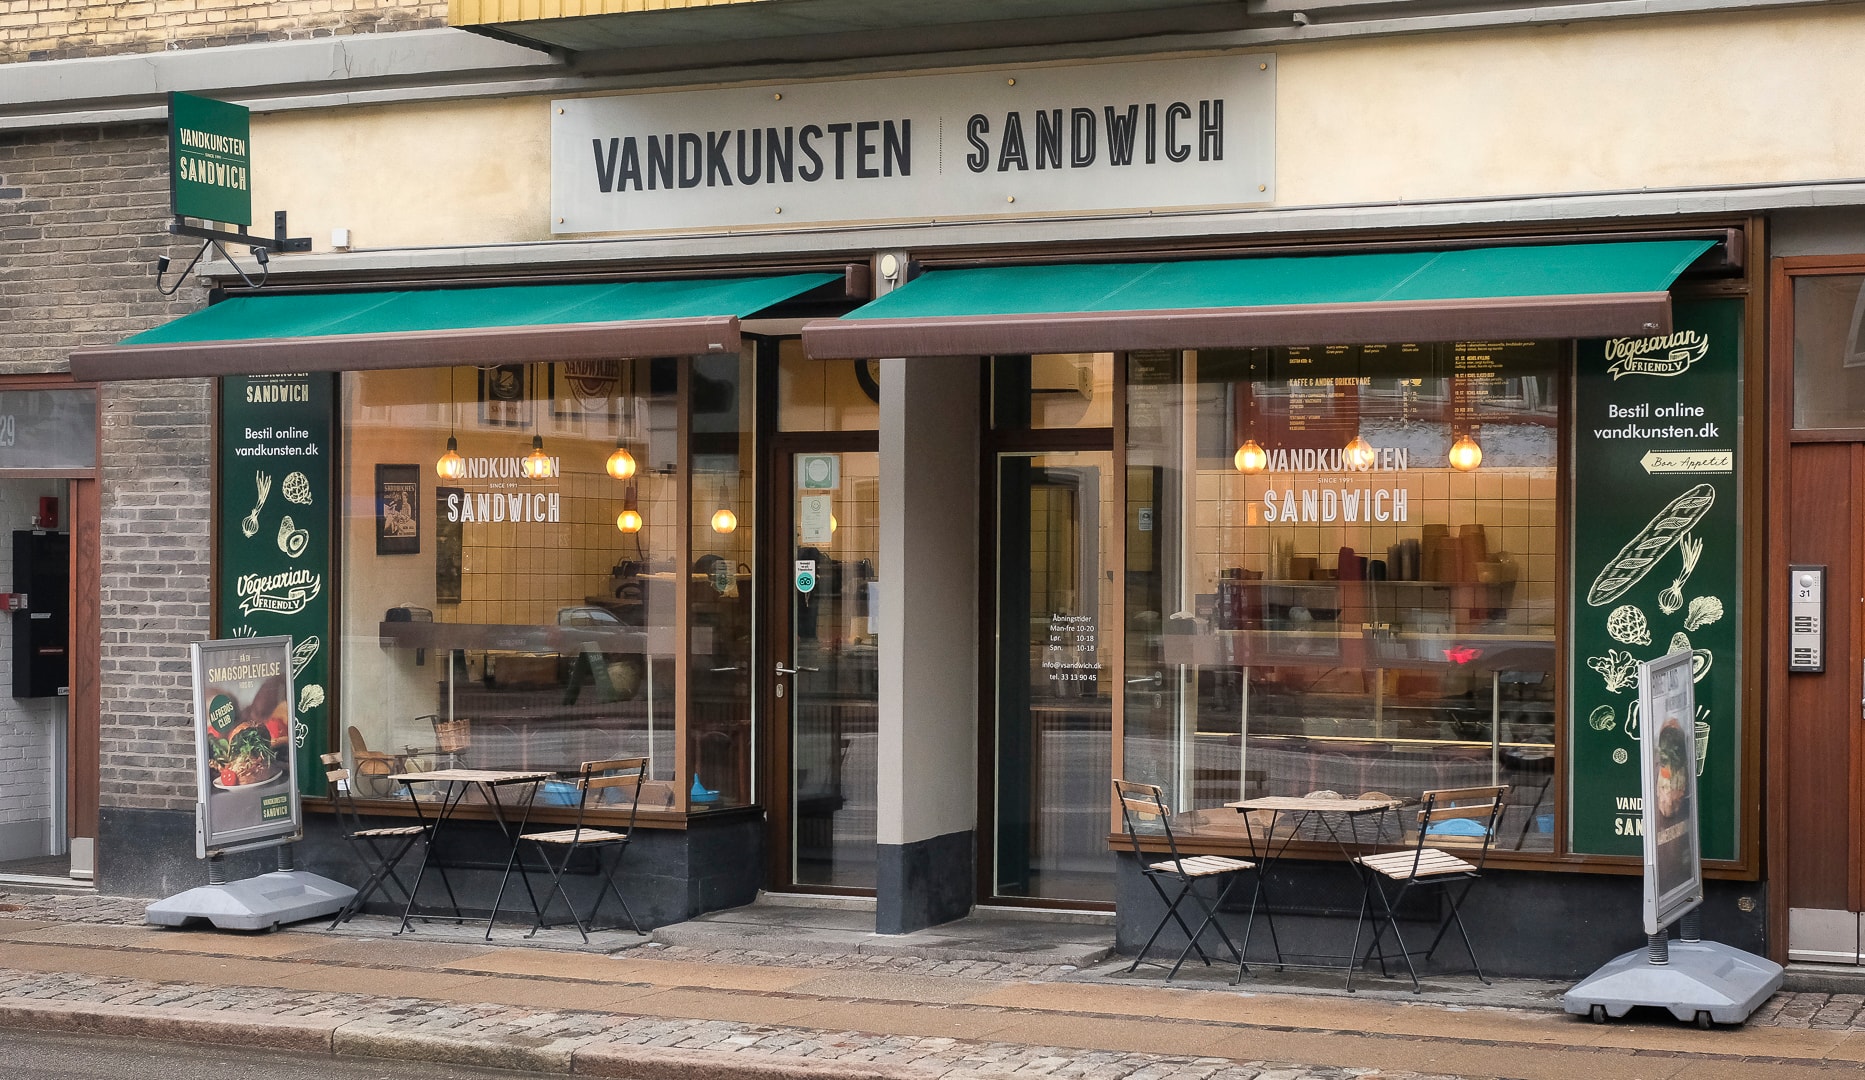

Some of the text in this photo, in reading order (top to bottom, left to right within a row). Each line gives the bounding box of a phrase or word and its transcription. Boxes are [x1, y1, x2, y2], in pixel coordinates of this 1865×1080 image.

[180, 127, 246, 156] VANDKUNSTEN
[592, 99, 1225, 193] VANDKUNSTEN SANDWICH
[180, 156, 247, 191] SANDWICH
[1604, 329, 1702, 371] Vegetarian
[1631, 361, 1684, 372] FRIENDLY
[1289, 377, 1308, 387] KAFFE
[246, 384, 309, 403] SANDWICH
[1608, 402, 1705, 418] Bestil online
[0, 414, 15, 447] 29
[245, 427, 309, 440] Bestil online
[1593, 422, 1720, 439] vandkunsten.dk
[235, 443, 319, 457] vandkunsten.dk
[449, 456, 560, 479] VANDKUNSTEN
[1265, 447, 1408, 473] VANDKUNSTEN
[1650, 456, 1729, 470] Bon Appetit
[447, 492, 560, 523] SANDWICH
[1263, 488, 1408, 522] SANDWICH
[237, 566, 315, 608] Vegetarian
[1799, 590, 1810, 598] 31
[258, 598, 300, 610] FRIENDLY
[1052, 613, 1092, 624] Åbningstider
[208, 662, 281, 683] SMAGSOPLEVELSE
[1042, 661, 1102, 670] info@vsandwich.dk
[1049, 673, 1060, 681] tel.
[210, 701, 235, 723] ALFREDOS
[218, 714, 232, 729] CLUB
